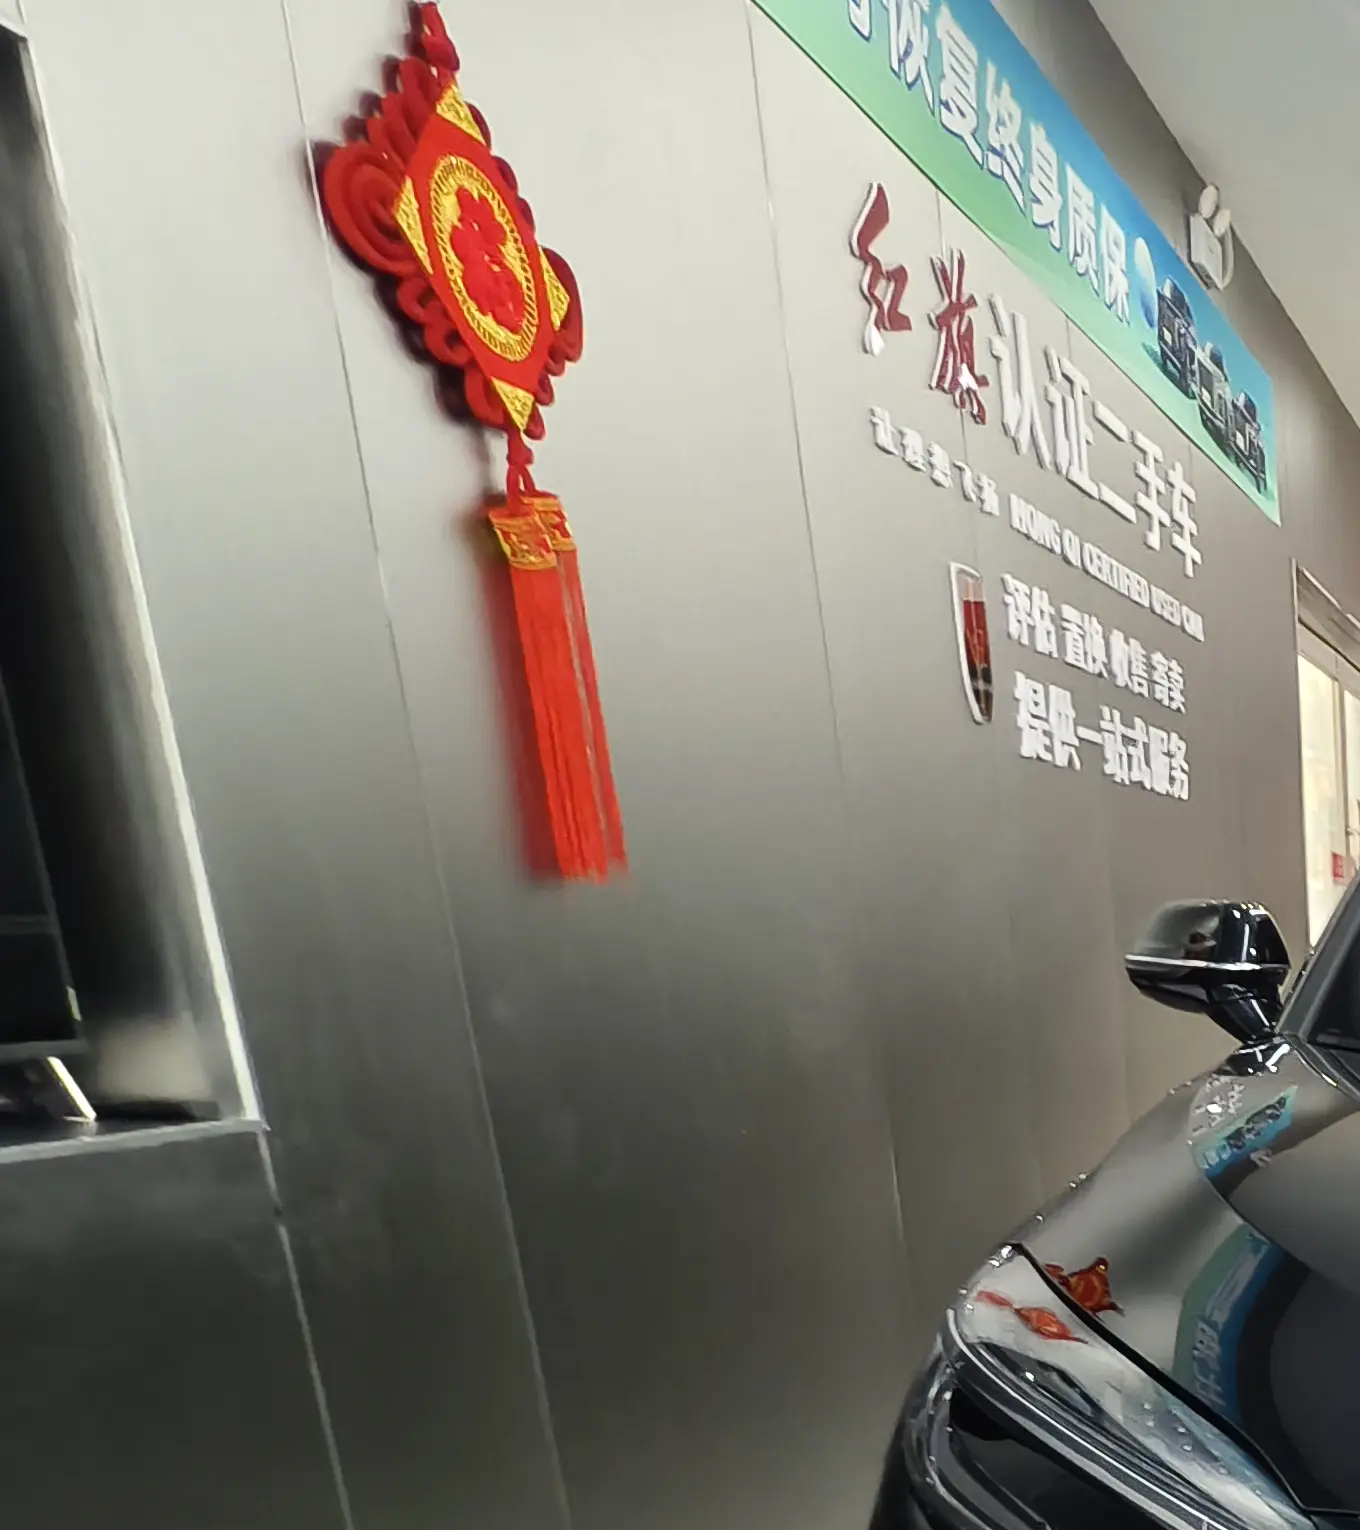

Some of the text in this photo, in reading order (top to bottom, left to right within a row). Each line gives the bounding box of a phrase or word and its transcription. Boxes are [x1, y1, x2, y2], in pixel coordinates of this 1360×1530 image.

[1014, 670, 1190, 801] 提供一站式服务
